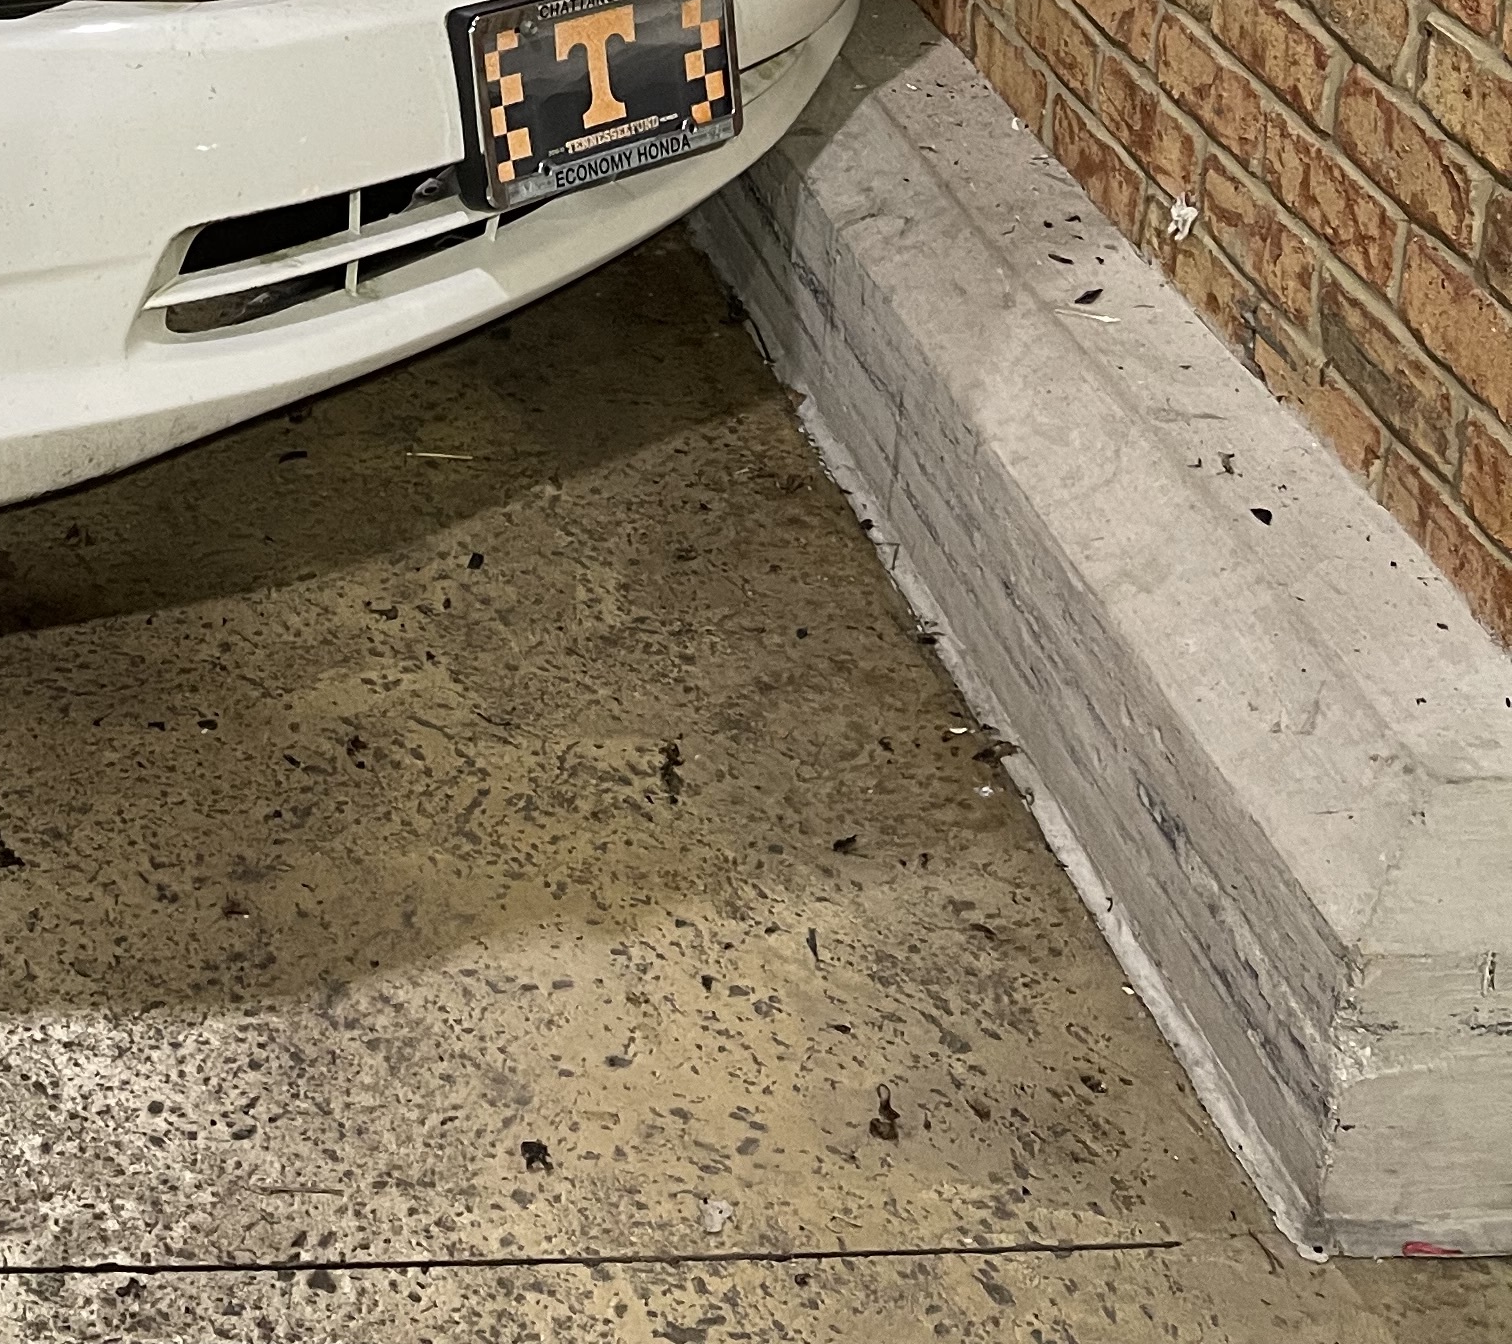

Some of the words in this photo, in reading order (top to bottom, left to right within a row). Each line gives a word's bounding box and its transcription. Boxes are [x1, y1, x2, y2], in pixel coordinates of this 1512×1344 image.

[554, 3, 637, 129] T
[555, 150, 633, 188] ECONOMY
[637, 133, 692, 161] HONDA
[565, 123, 631, 154] TENNESSEE
[632, 114, 660, 134] FUND
